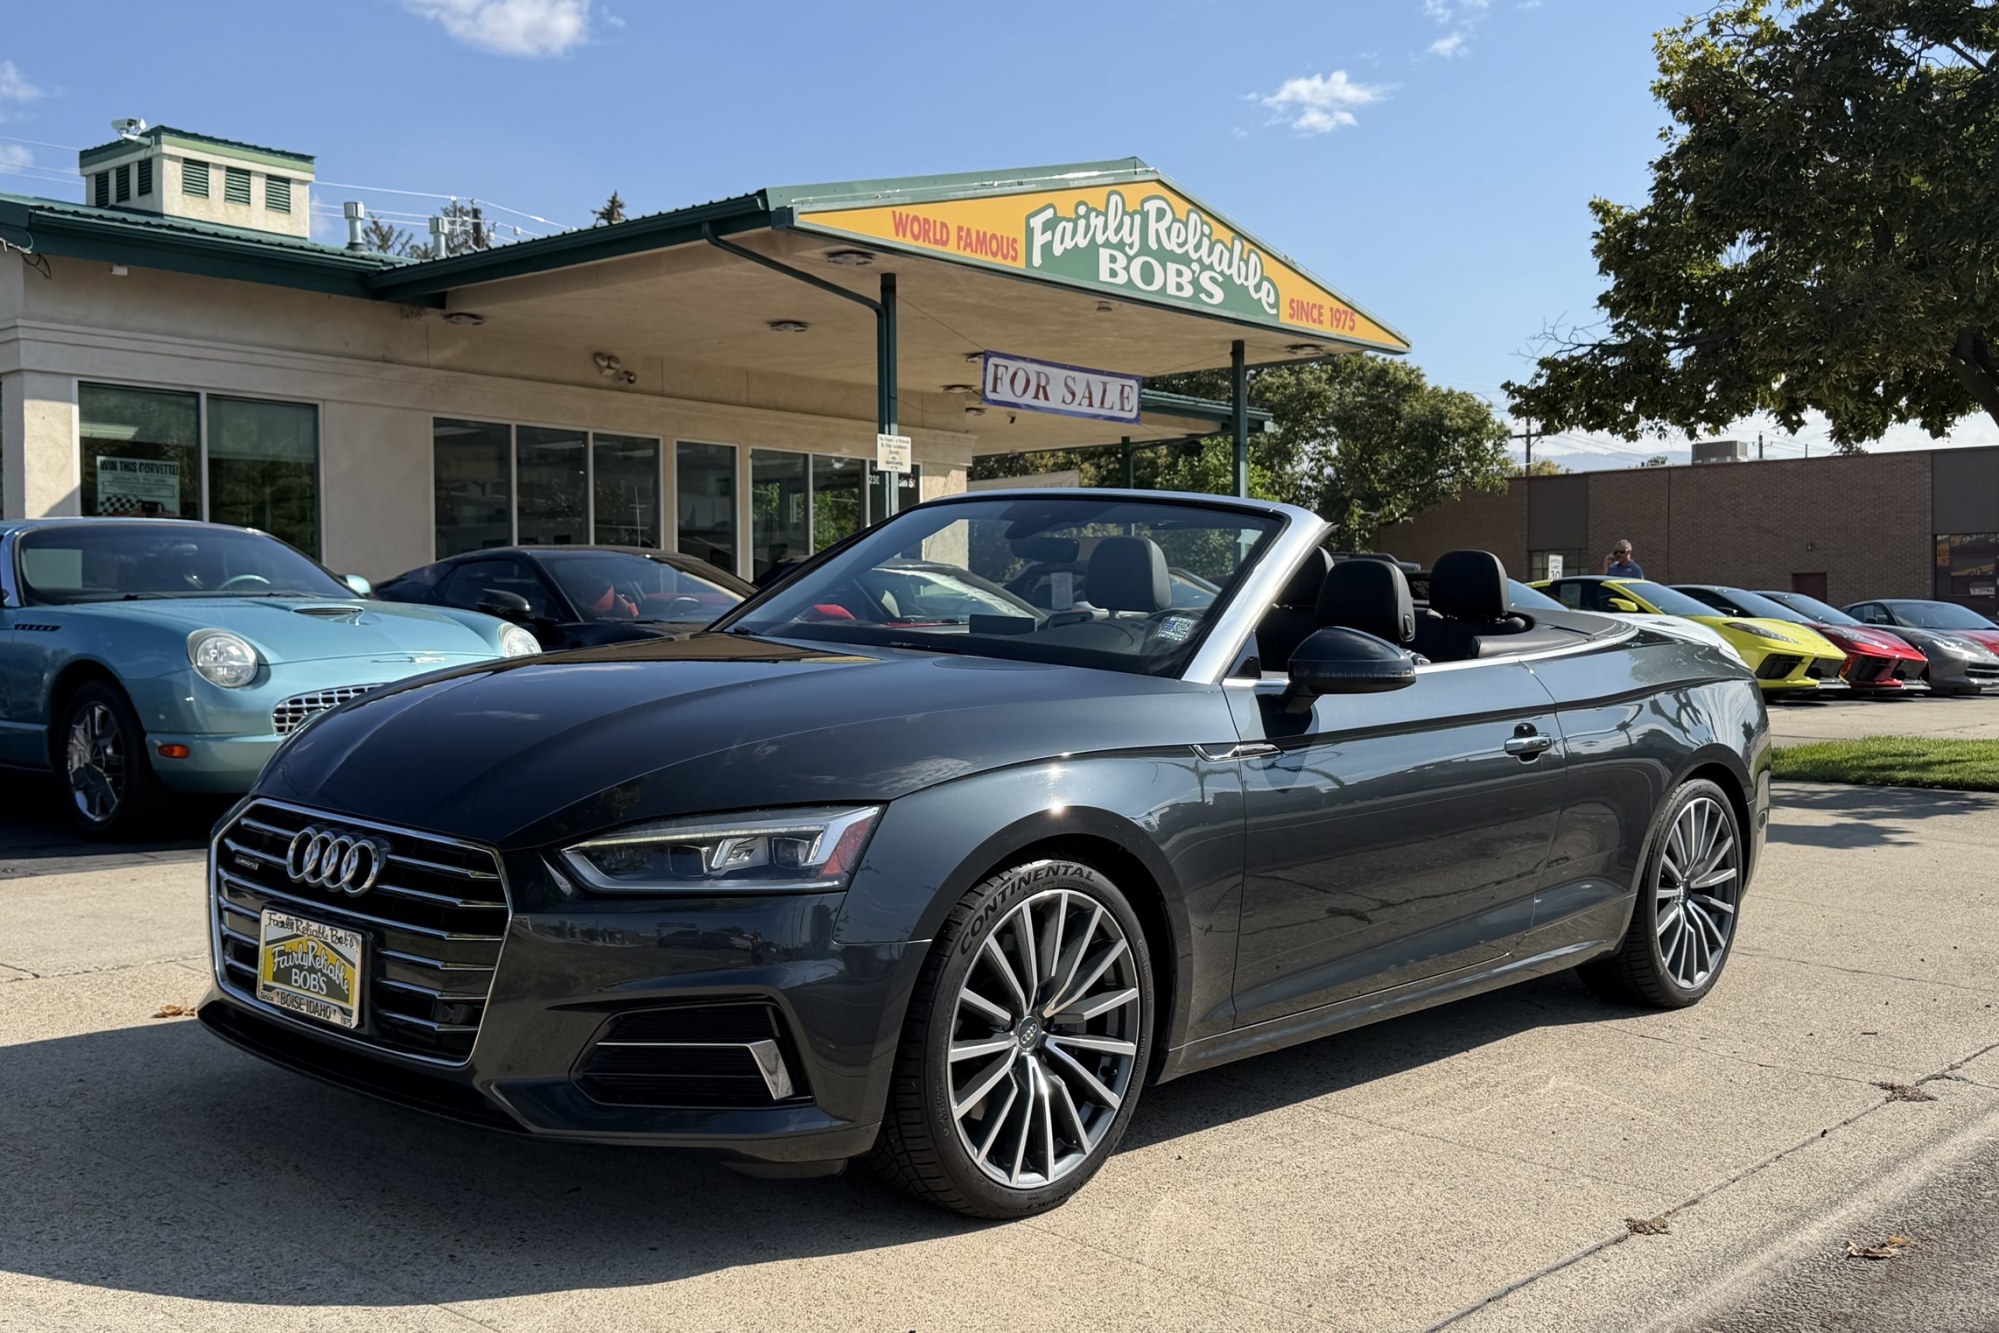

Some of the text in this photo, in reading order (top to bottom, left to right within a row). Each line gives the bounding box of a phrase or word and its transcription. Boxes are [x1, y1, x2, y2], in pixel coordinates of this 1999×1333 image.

[892, 210, 1018, 262] WORLD FAMOUS
[1030, 194, 1277, 315] Fairly Reliable
[1099, 247, 1225, 305] BOB'S
[1289, 298, 1356, 332] SINCE 1975
[990, 362, 1134, 413] FOR SALE
[100, 460, 118, 472] WIN
[120, 461, 137, 473] THIS
[960, 864, 1095, 956] CONTINENTAL
[272, 940, 350, 995] Fairly Reliable
[291, 968, 327, 996] BOB'S
